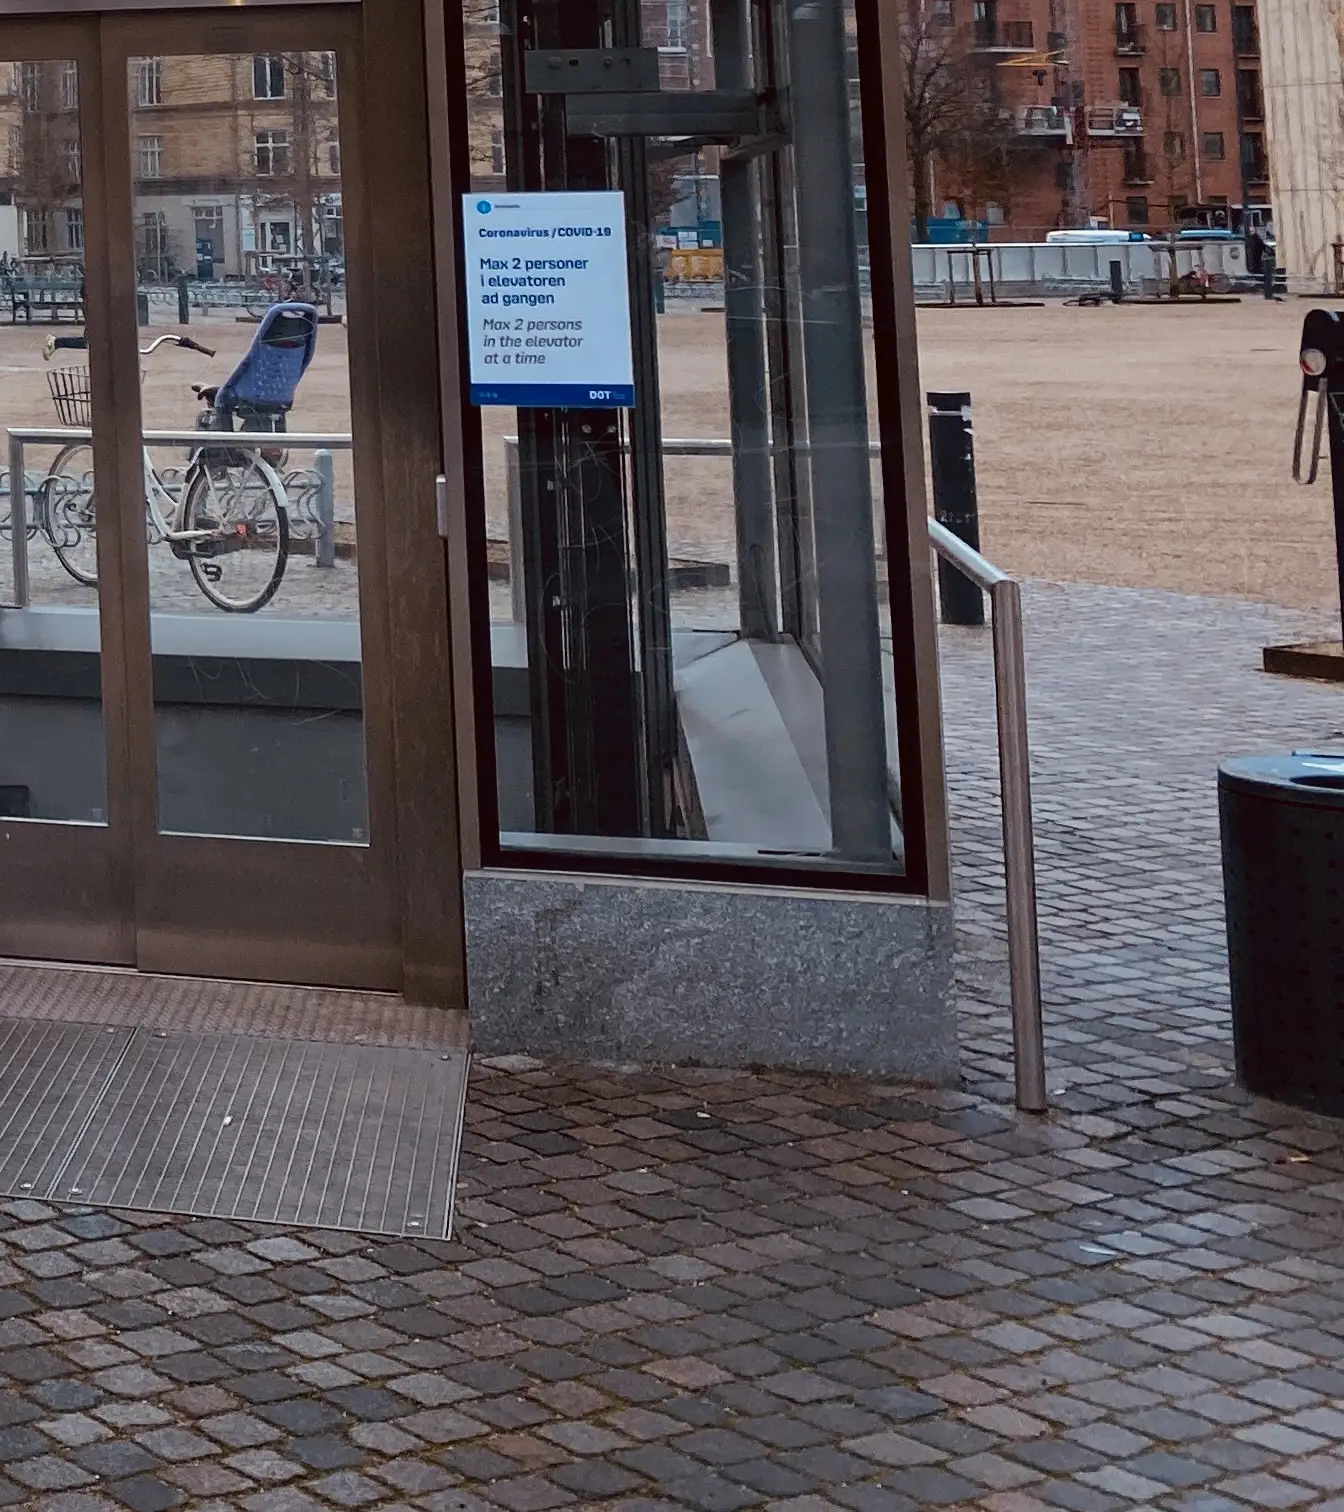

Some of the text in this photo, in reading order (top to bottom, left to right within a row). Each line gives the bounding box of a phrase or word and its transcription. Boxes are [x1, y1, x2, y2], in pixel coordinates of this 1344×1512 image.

[479, 227, 549, 238] Coronavirus
[480, 258, 589, 272] Max 2 personer
[480, 274, 566, 287] i elevatoren
[481, 292, 555, 307] ad gangen
[482, 318, 583, 332] Max 2 persons
[483, 335, 584, 348] in the elevator
[484, 352, 547, 365] at a time
[588, 390, 612, 400] DOT
